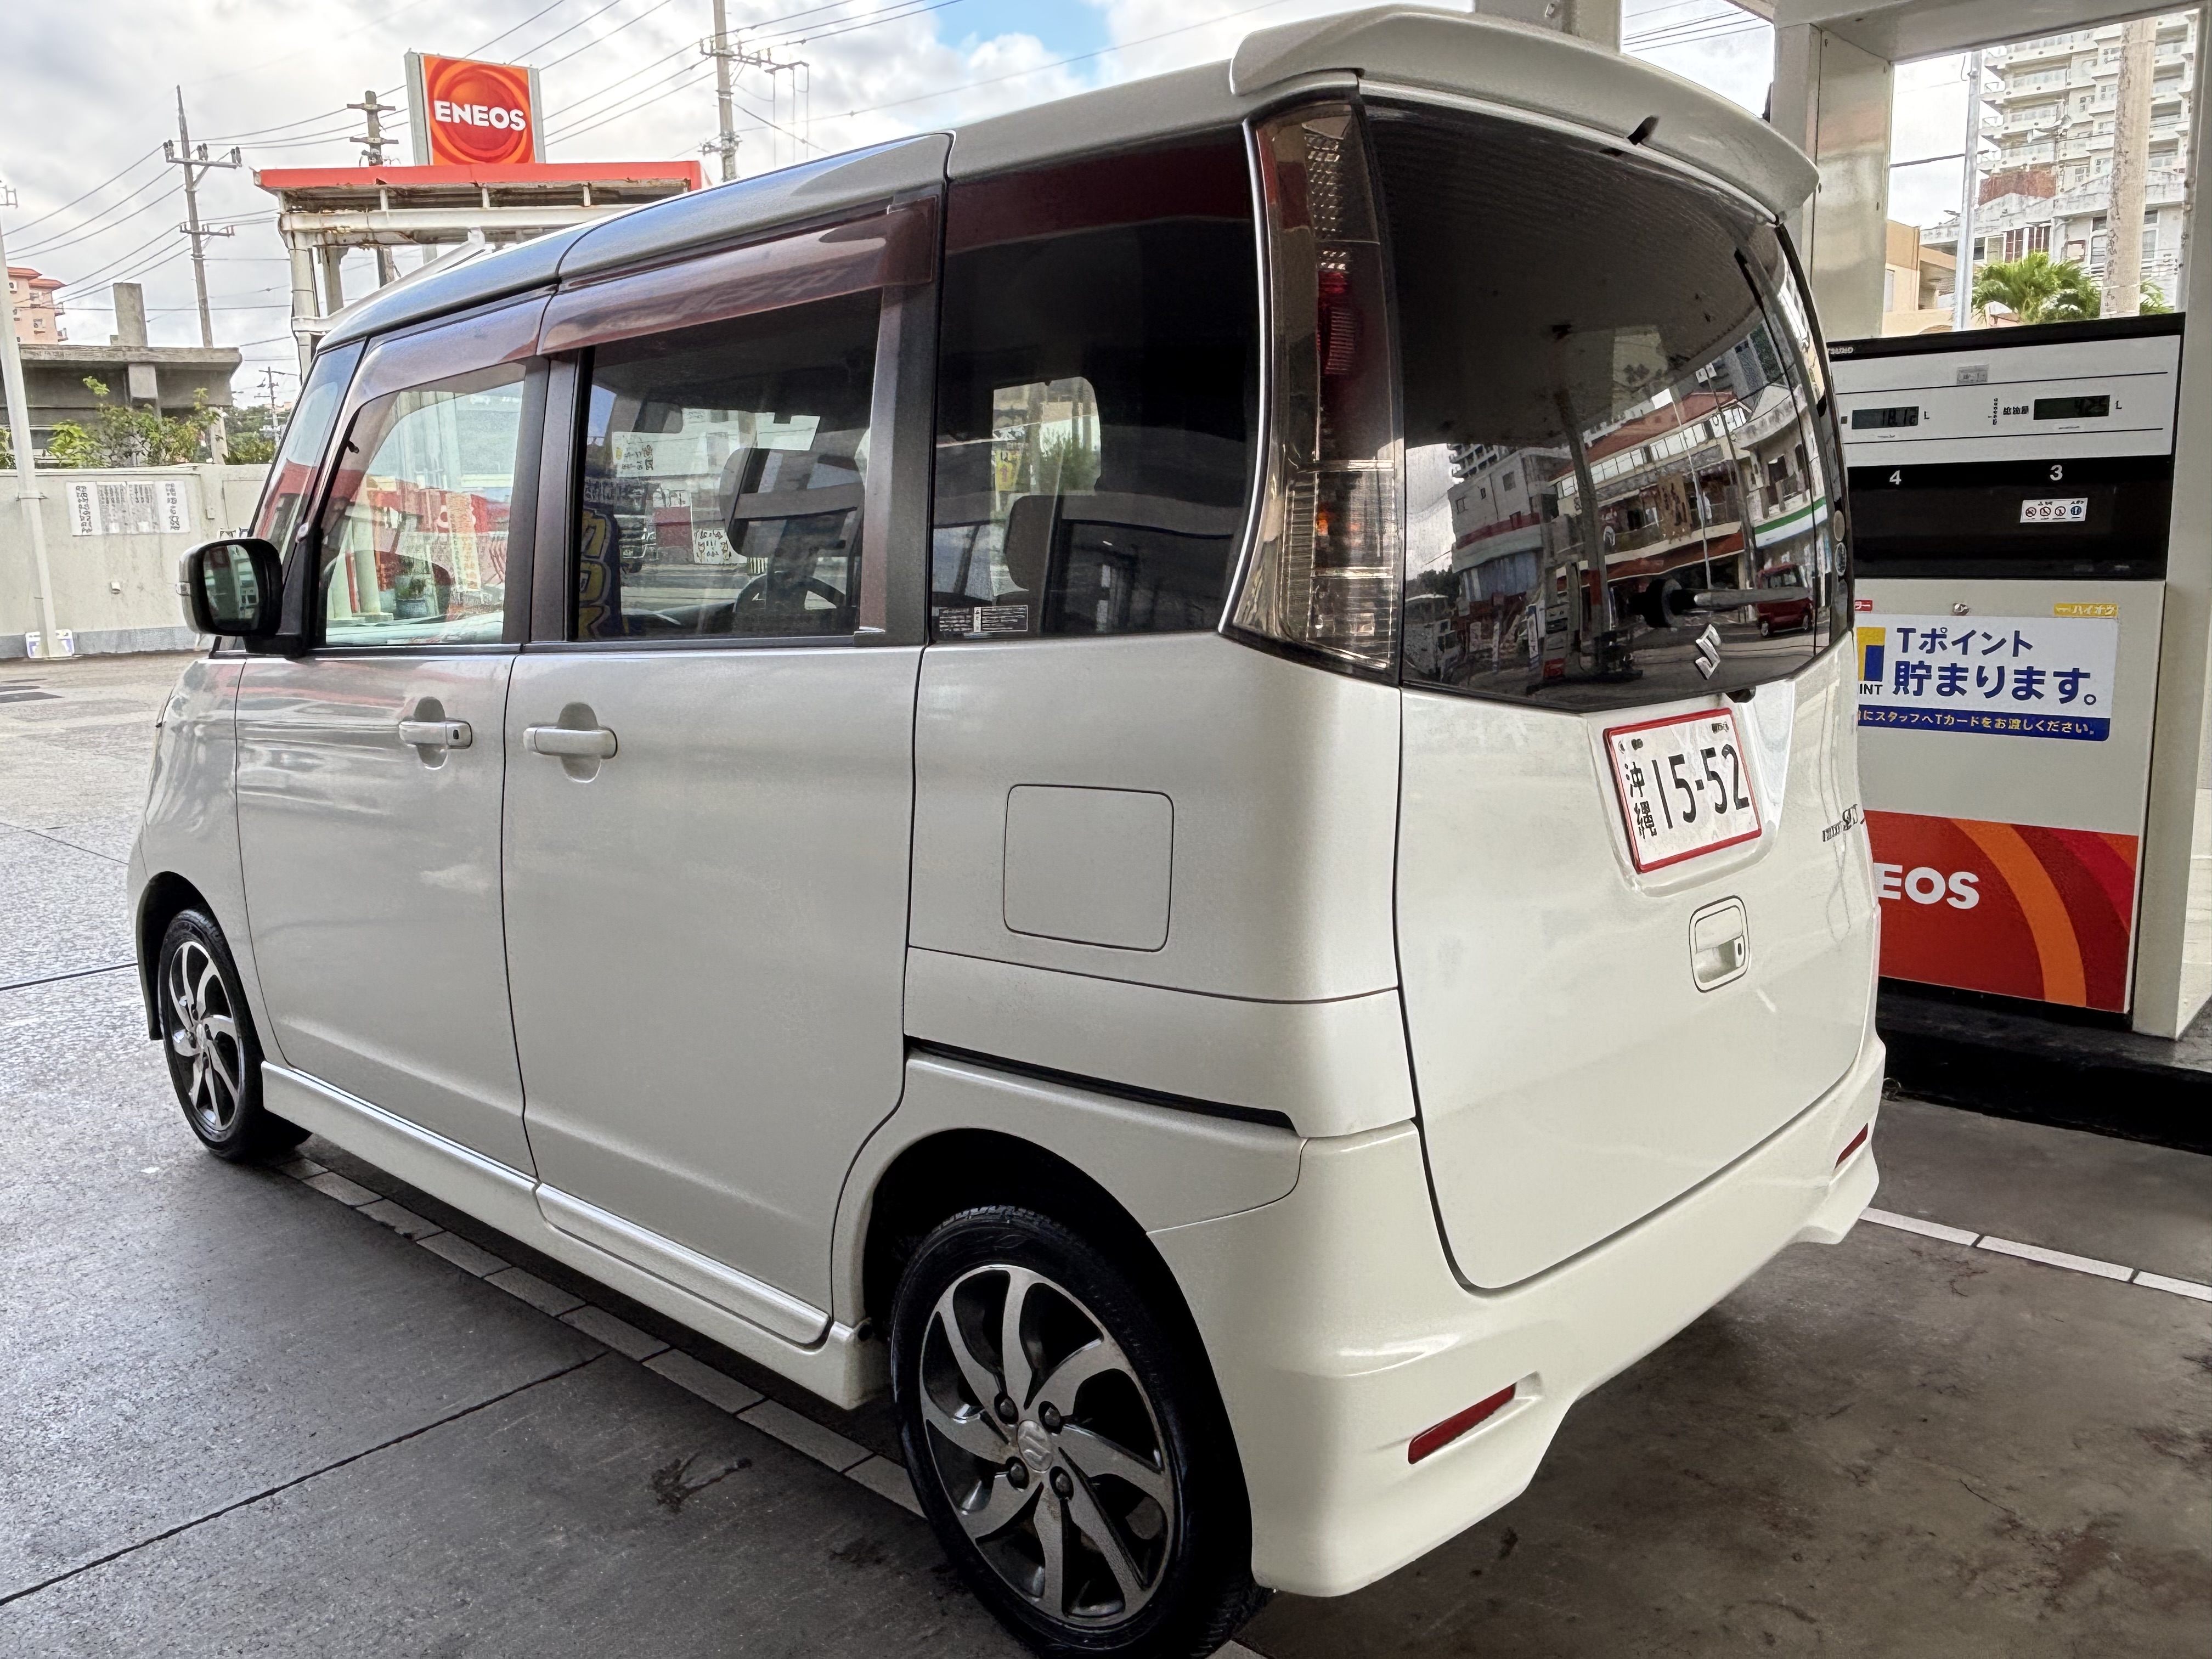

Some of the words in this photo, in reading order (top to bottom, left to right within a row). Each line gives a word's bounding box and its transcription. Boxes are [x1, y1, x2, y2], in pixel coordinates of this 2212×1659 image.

[434, 100, 526, 131] ENEOS
[1924, 411, 1929, 419] L
[2115, 400, 2122, 409] L
[1889, 470, 1902, 485] 4
[2050, 465, 2063, 481] 3
[1897, 627, 2033, 657] Tポイント
[1892, 660, 2097, 706] 貯まります。
[1651, 744, 1750, 829] 15-52
